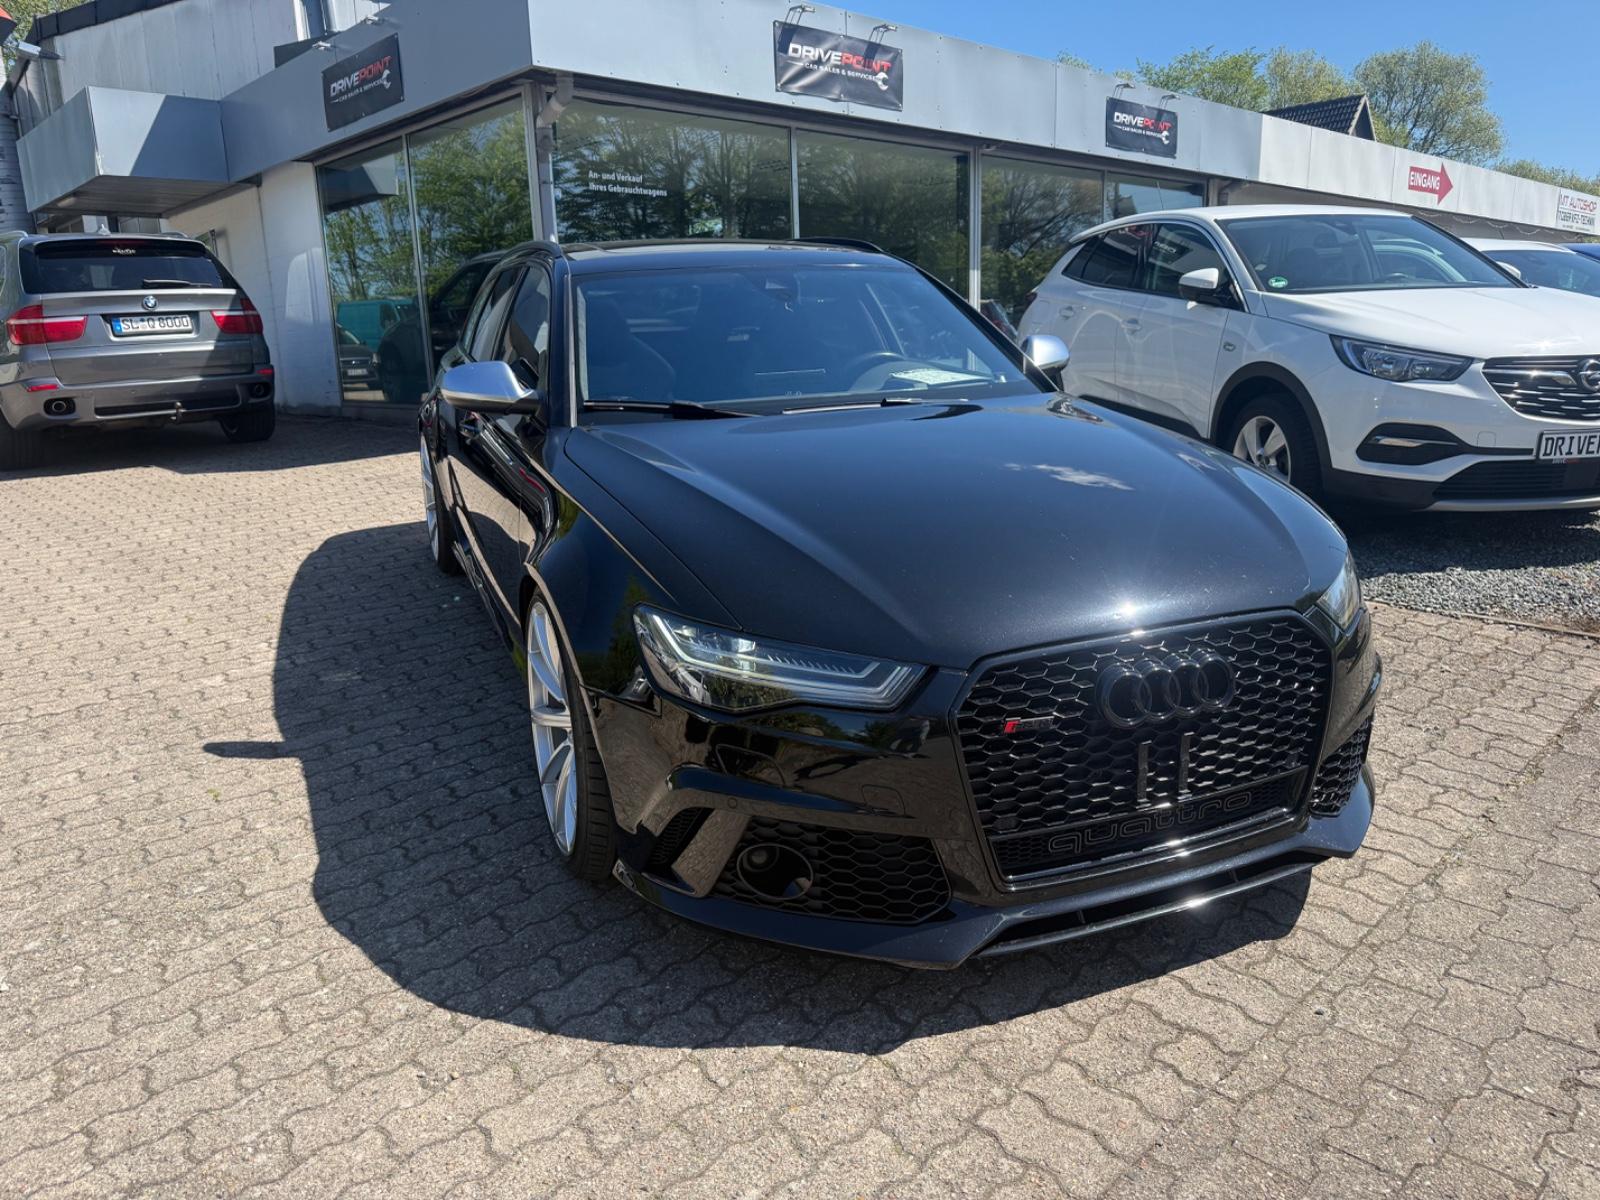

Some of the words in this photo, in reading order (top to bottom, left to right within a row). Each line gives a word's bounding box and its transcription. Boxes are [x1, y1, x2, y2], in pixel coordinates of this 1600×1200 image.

[788, 42, 892, 73] DRIVEPOINT
[330, 55, 392, 97] DRIVEPOINT
[804, 62, 818, 70] CAR
[819, 65, 840, 74] SALES
[588, 170, 601, 179] An-
[602, 172, 616, 180] und
[616, 172, 643, 183] Verkauf
[1410, 171, 1440, 190] EINGANG
[589, 182, 607, 192] Ihres
[608, 184, 667, 198] Gebrauchtwagens
[1569, 197, 1597, 212] AUTOSHOP
[122, 318, 139, 330] SL
[158, 316, 190, 328] 8000
[1048, 791, 1252, 853] quattro
